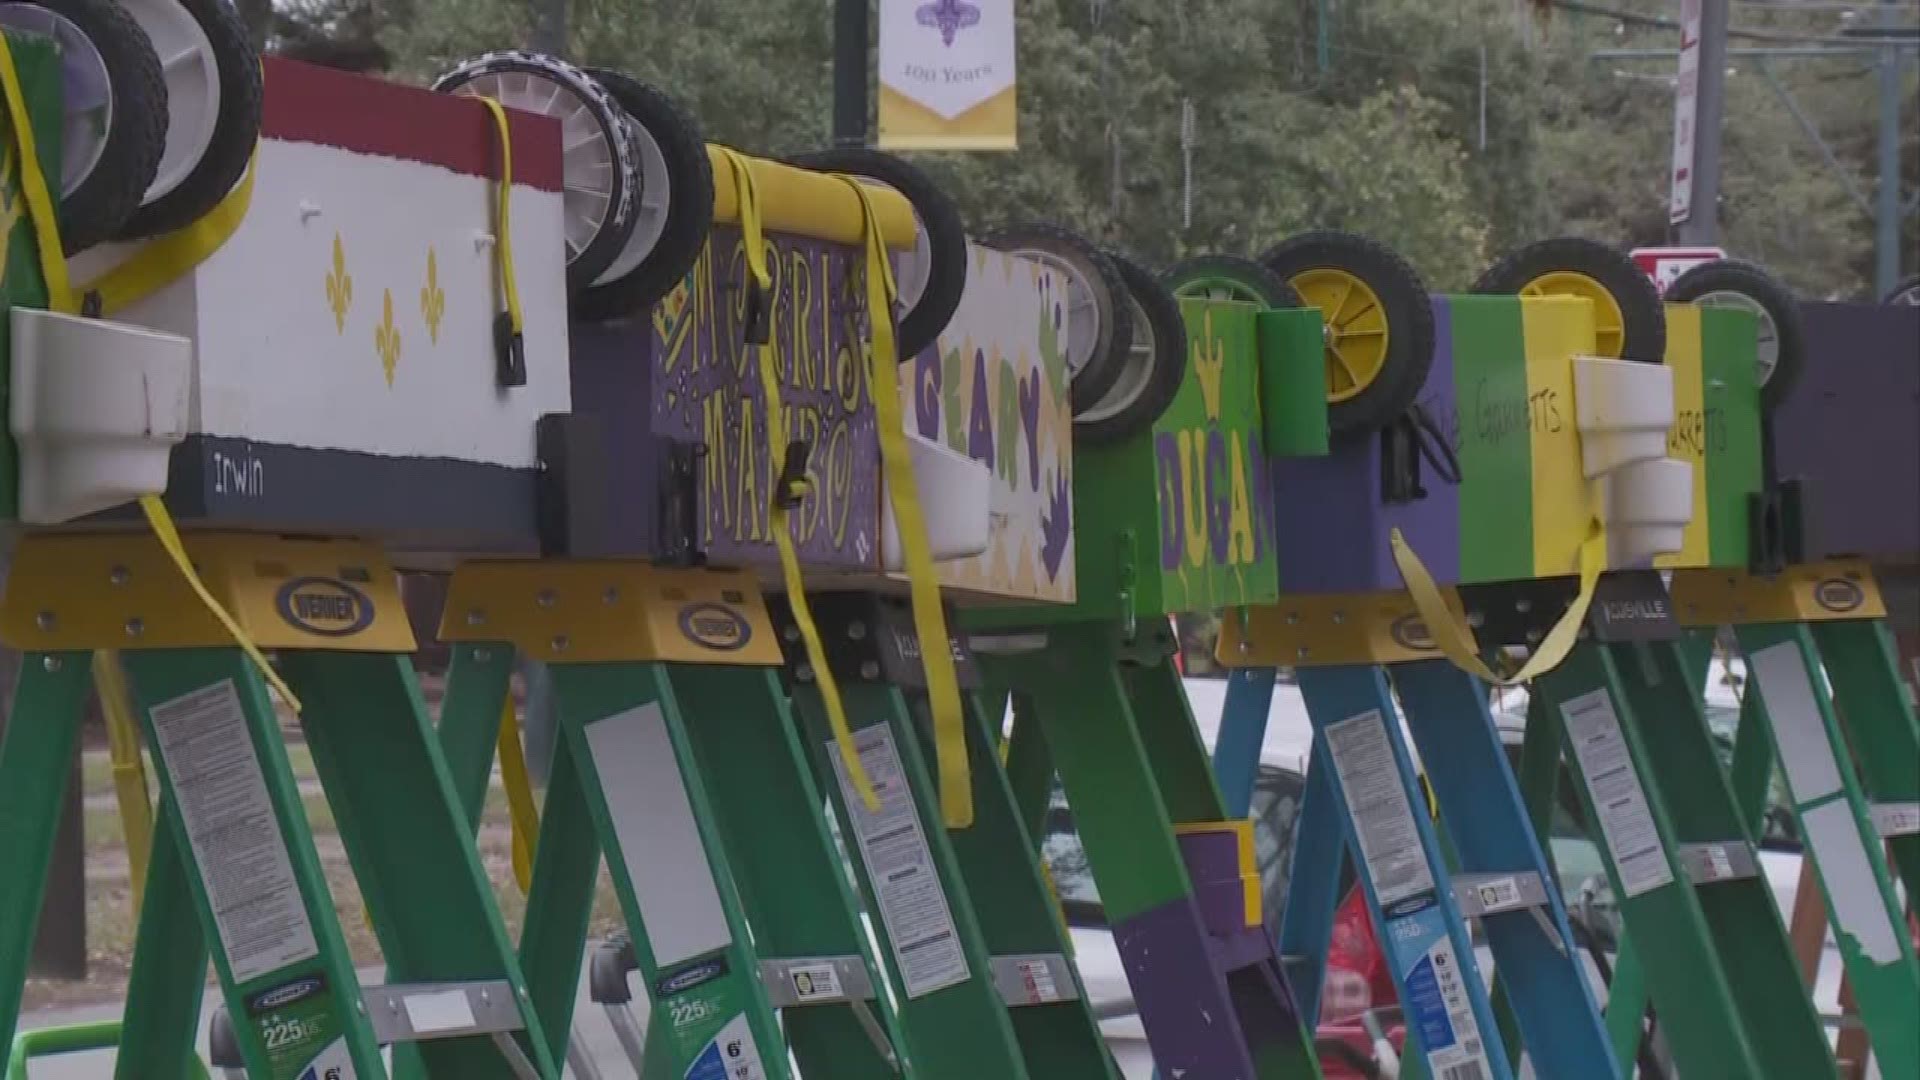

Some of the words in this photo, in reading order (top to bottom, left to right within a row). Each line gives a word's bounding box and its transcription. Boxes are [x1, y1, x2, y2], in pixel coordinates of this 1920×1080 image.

[903, 63, 937, 83] 100
[943, 64, 993, 84] Years
[915, 340, 1040, 493] GEARY
[214, 444, 263, 497] Irwin
[1155, 427, 1277, 573] DUGAN
[263, 1019, 303, 1049] 225
[671, 1000, 705, 1027] 225
